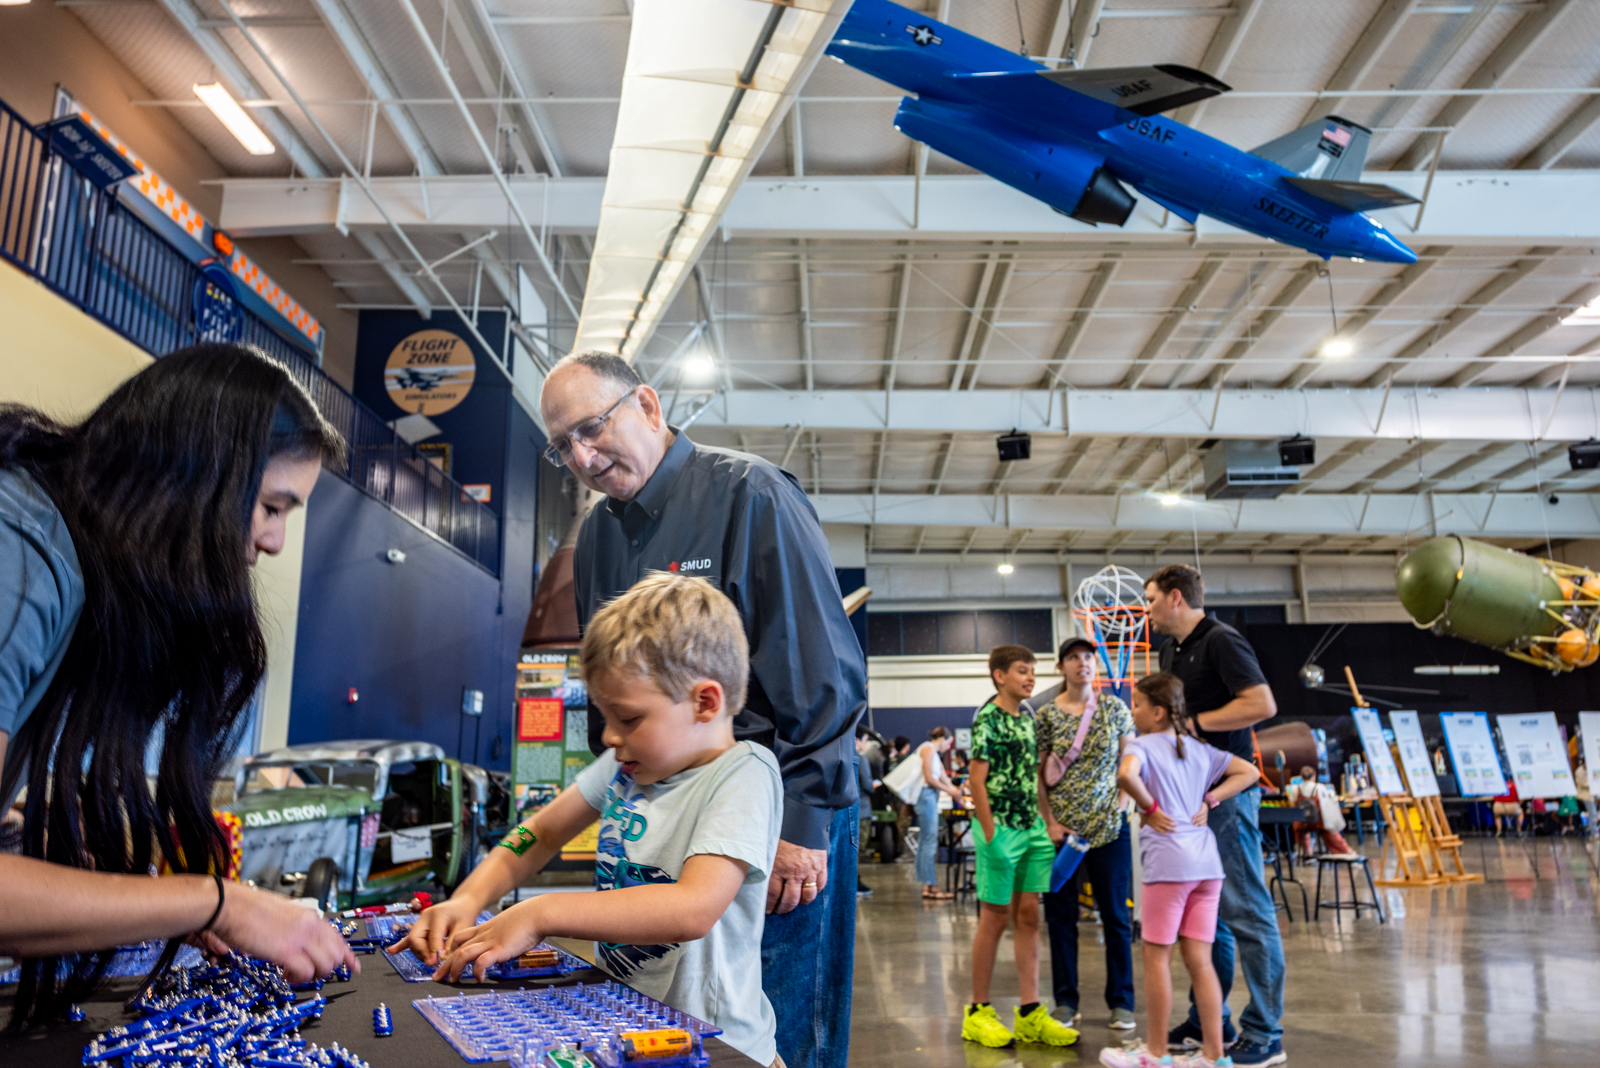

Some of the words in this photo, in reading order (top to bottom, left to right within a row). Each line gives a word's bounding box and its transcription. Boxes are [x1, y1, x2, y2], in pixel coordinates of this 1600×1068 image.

[1111, 79, 1153, 97] USAF
[1126, 118, 1177, 144] USAF
[1254, 197, 1330, 239] SKEETER
[401, 338, 459, 352] FLIGHT
[406, 351, 452, 365] ZONE
[680, 558, 712, 571] SMUD
[522, 654, 541, 664] OLD
[541, 653, 568, 664] CROW
[245, 808, 282, 827] OLD
[282, 803, 327, 822] CROW
